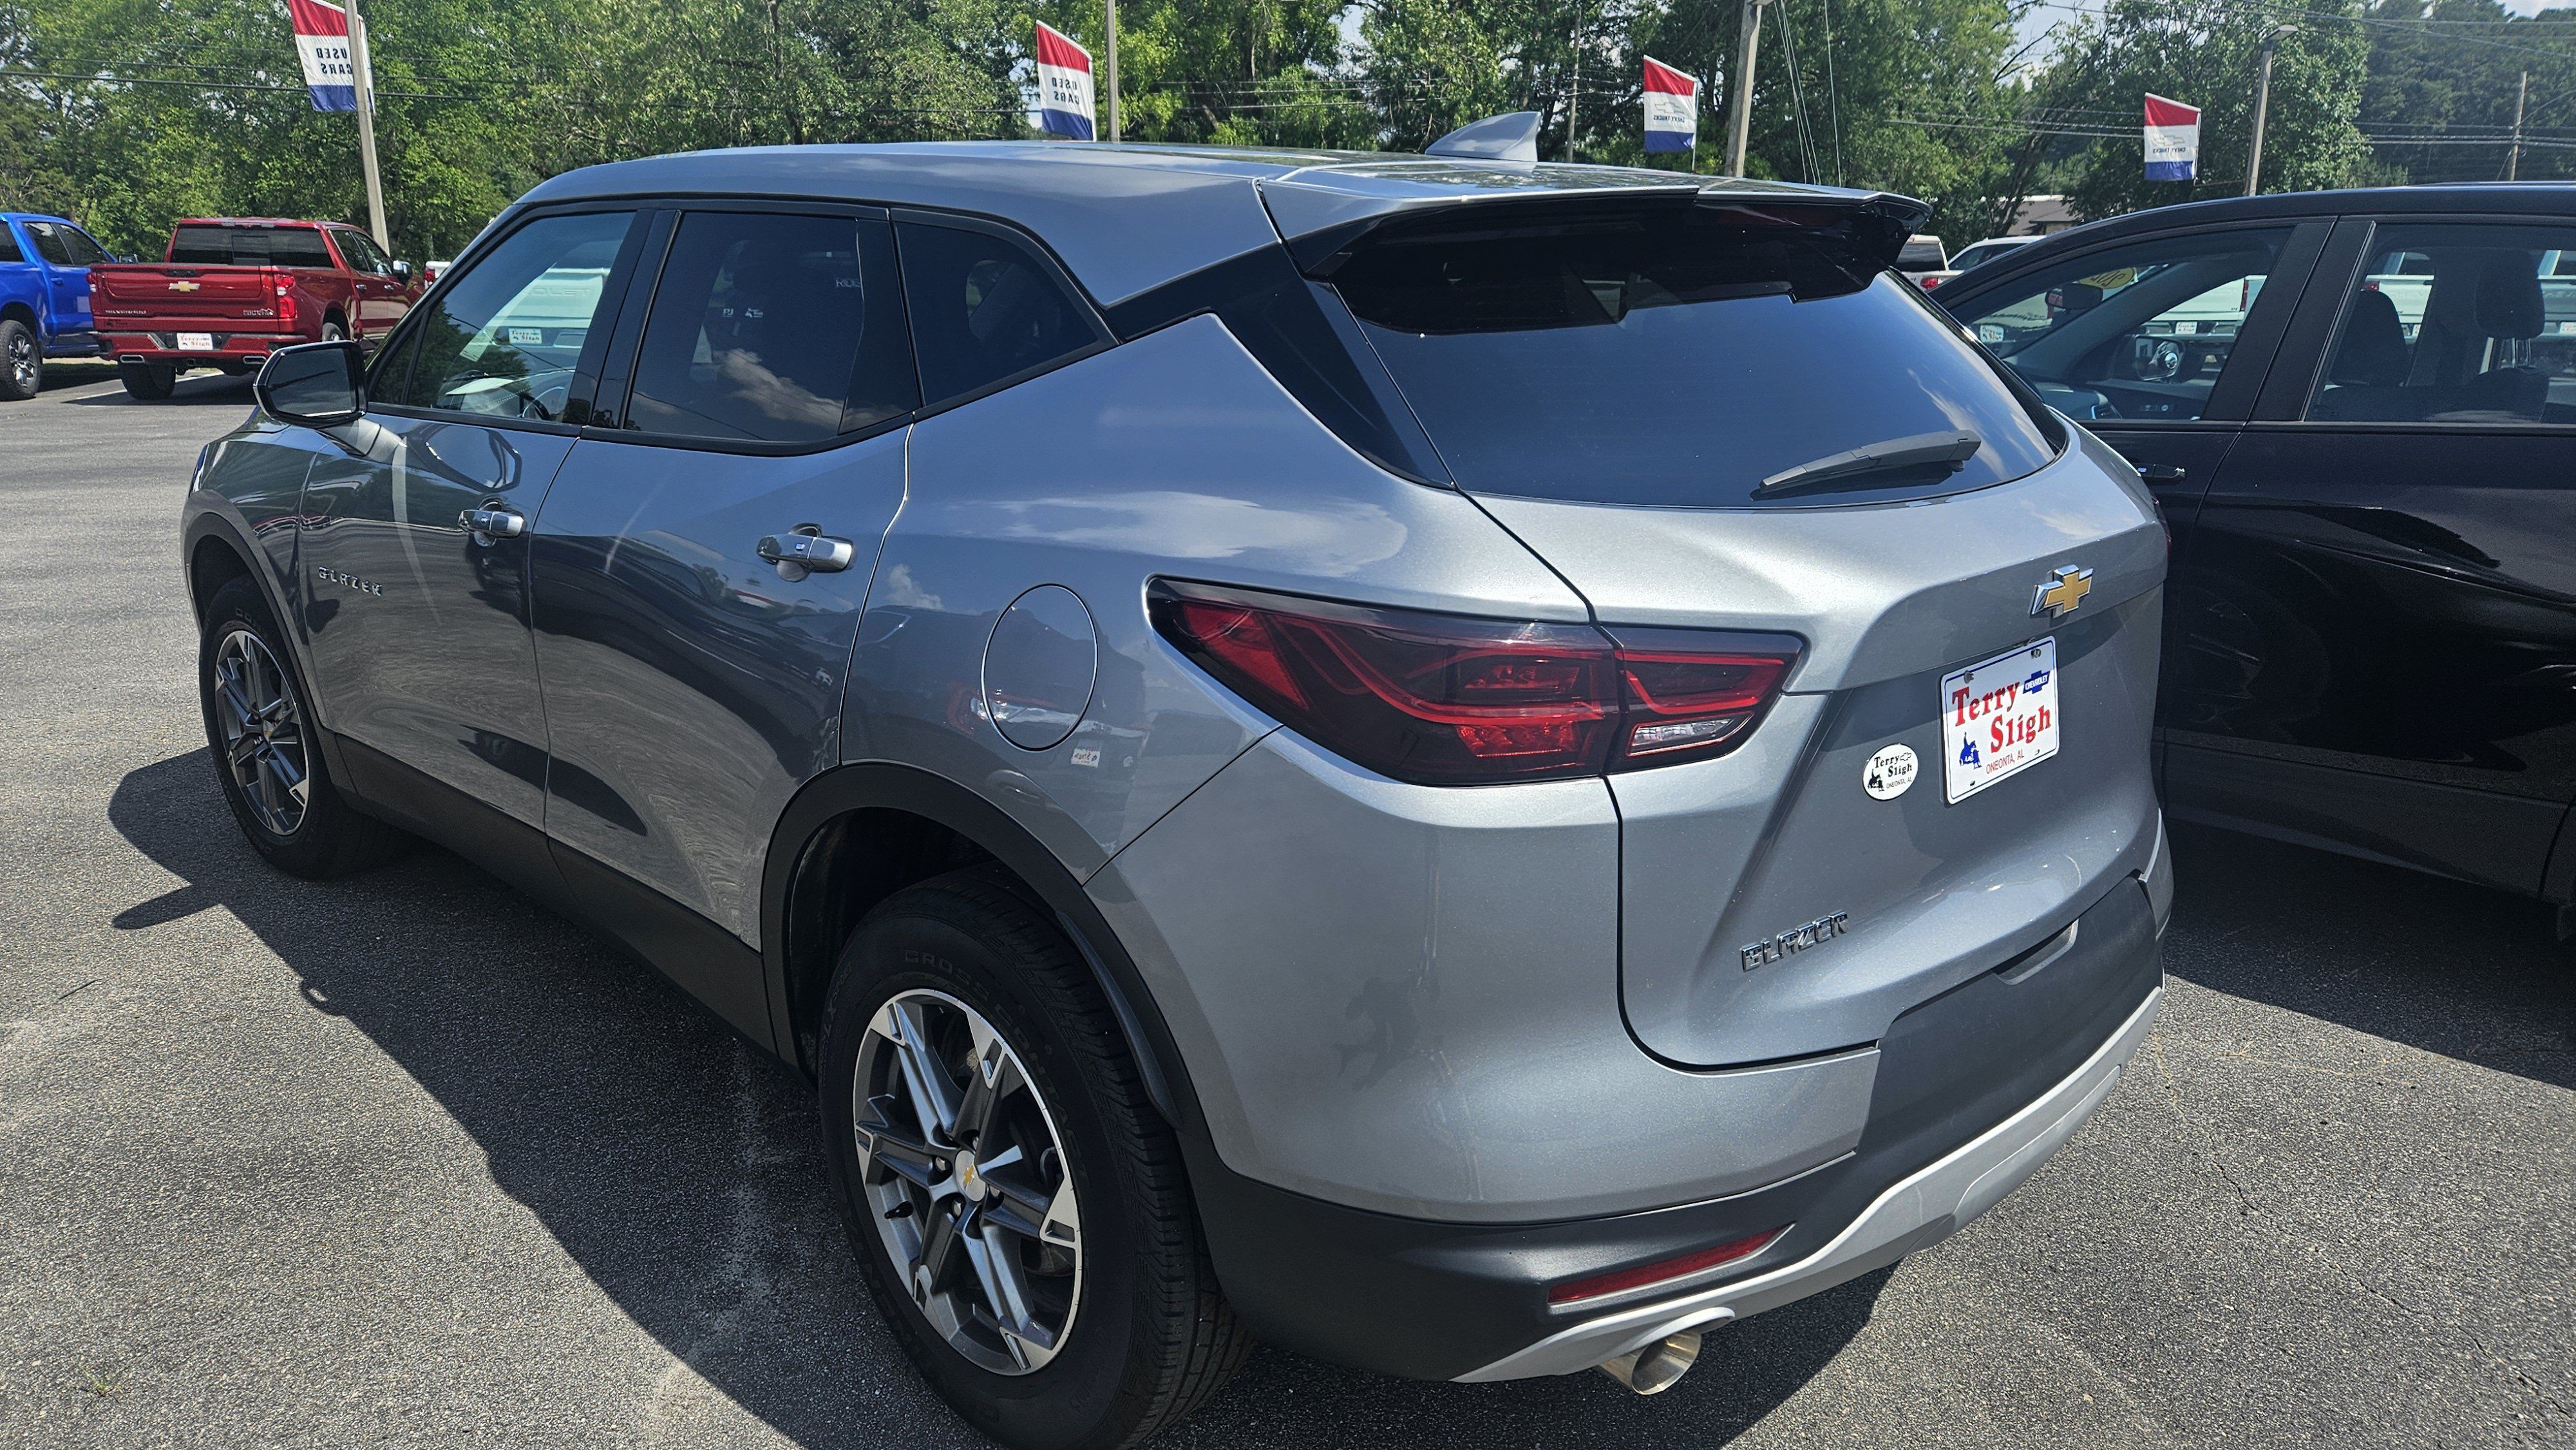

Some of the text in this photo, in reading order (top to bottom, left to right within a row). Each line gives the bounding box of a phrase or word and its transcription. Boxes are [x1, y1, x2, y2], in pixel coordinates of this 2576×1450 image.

[318, 566, 383, 596] BLAZER
[1952, 675, 2049, 727] Terry CHEVROLET
[1990, 704, 2052, 753] Sligh
[1874, 755, 1900, 768] Terry
[1888, 762, 1913, 777] Sligh
[2017, 749, 2025, 761] AL
[1739, 909, 1849, 972] BLAZER
